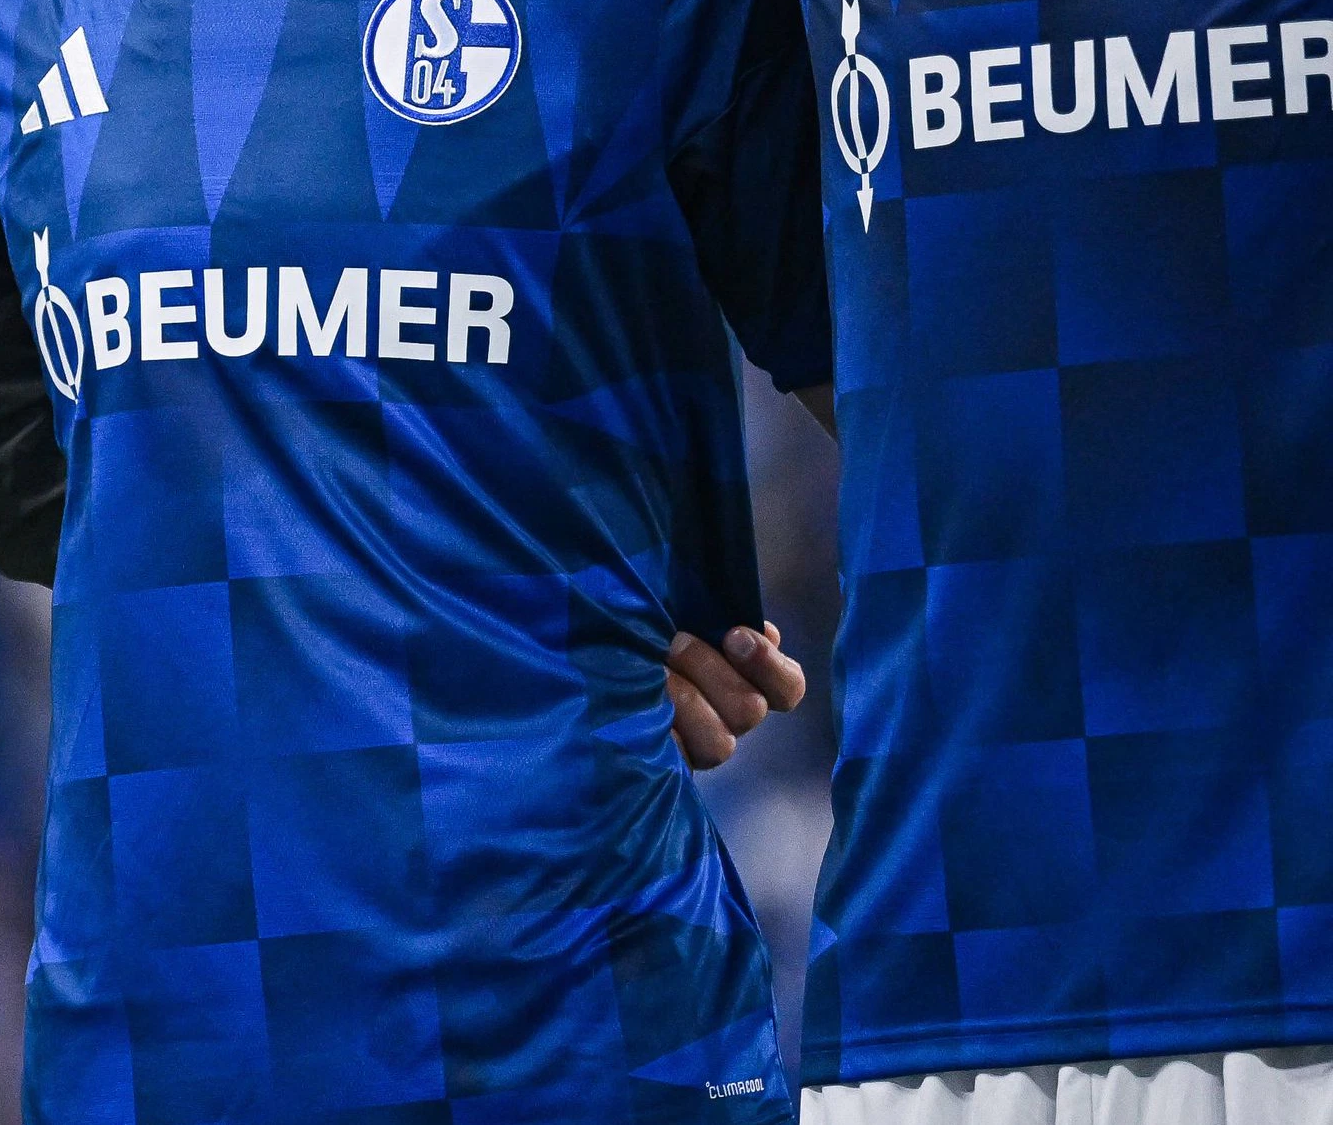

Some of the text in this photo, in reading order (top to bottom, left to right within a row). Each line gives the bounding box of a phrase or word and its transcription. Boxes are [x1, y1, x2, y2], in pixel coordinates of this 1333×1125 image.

[411, 59, 457, 106] 04
[908, 20, 1333, 150] BEUMER
[85, 266, 514, 371] BEUMER
